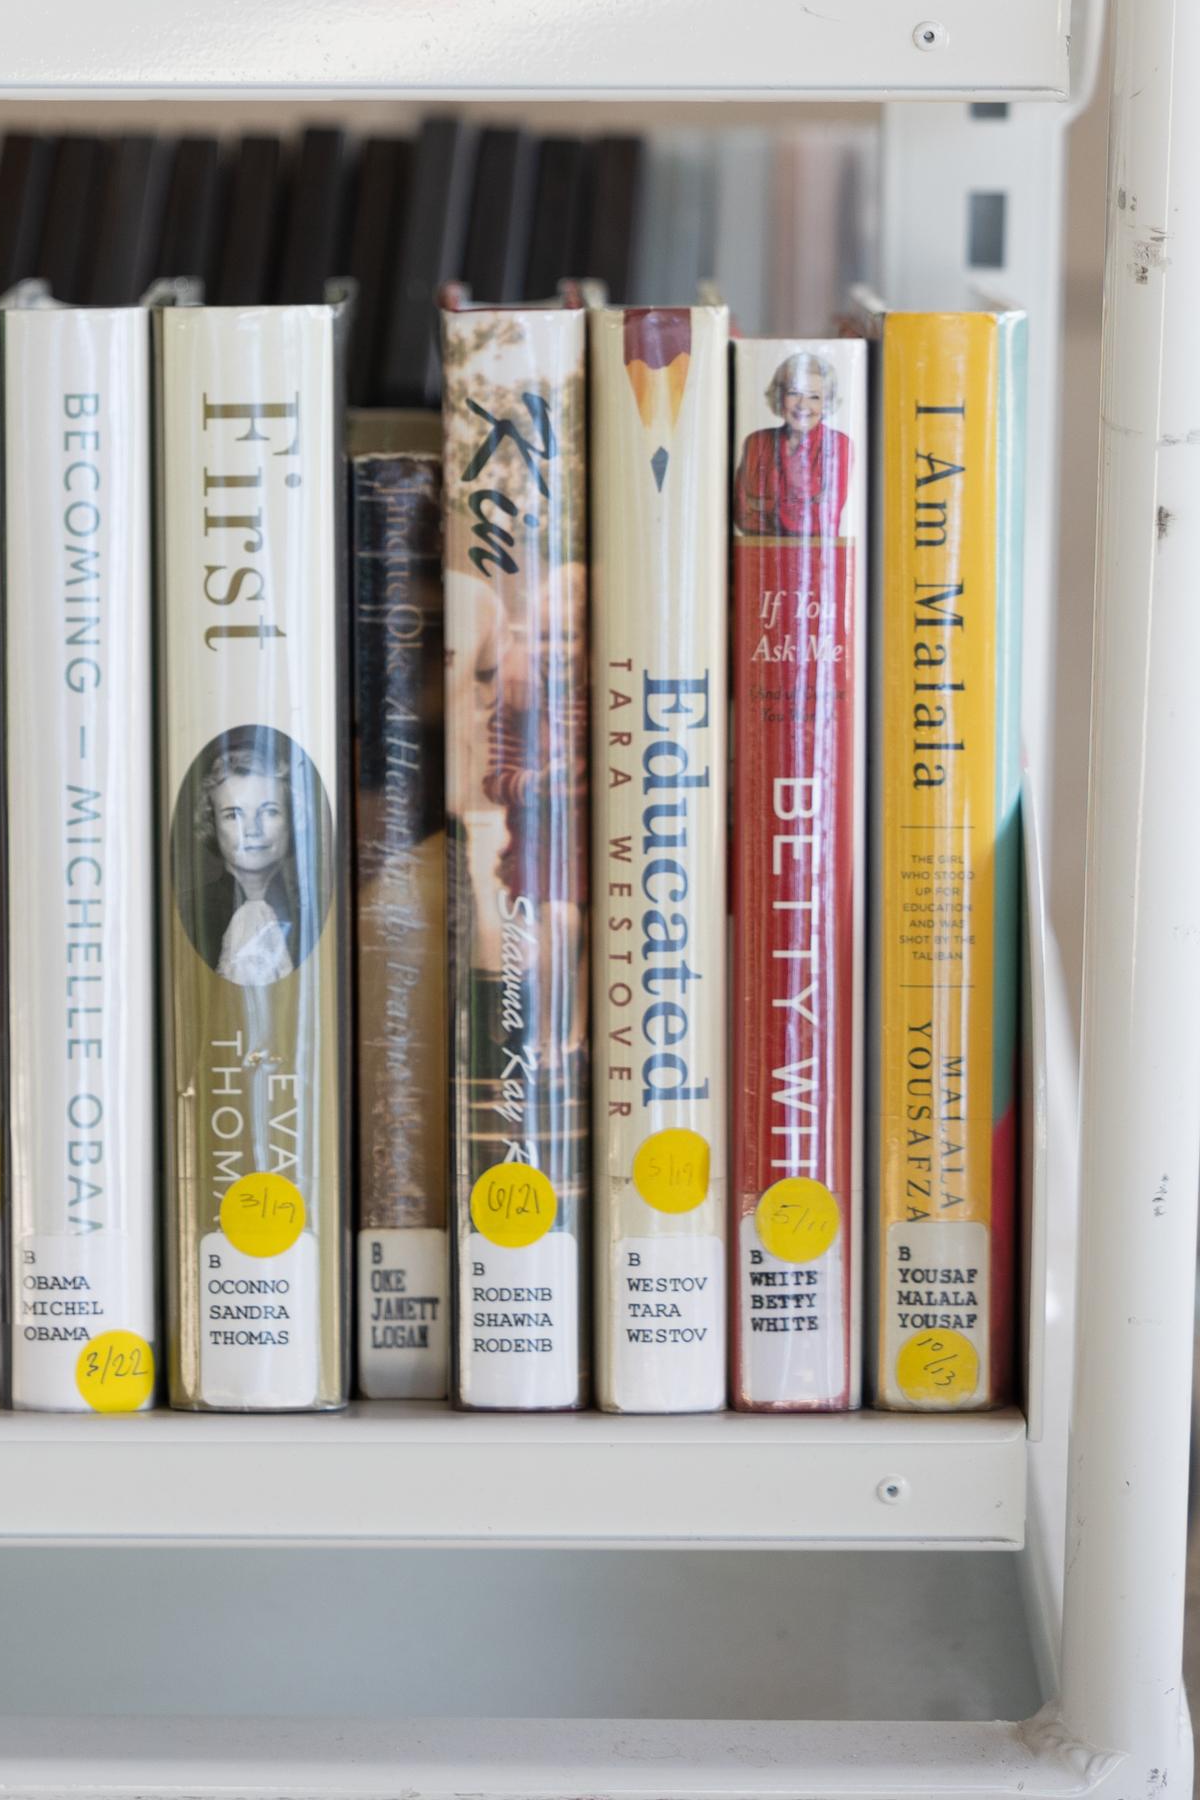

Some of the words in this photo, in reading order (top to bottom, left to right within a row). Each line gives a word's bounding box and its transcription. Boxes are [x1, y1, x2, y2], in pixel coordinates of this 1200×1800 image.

[915, 404, 965, 421] I
[64, 393, 100, 694] BECOMING
[202, 391, 302, 652] First
[461, 393, 556, 578] Kin
[914, 451, 965, 549] Am
[609, 659, 632, 789] TARA
[914, 579, 965, 790] Malala
[66, 783, 102, 1059] MICHELLE
[642, 668, 709, 1107] Educated
[771, 777, 819, 1024] BETTY
[608, 835, 633, 1118] WESTOVER
[209, 1305, 290, 1320] SANDRA
[209, 1331, 288, 1345] THOMAS
[473, 1312, 553, 1327] SHAWNA
[751, 1293, 816, 1309] BETTY
[751, 1316, 818, 1332] WHITE
[897, 1291, 978, 1306] MALALA
